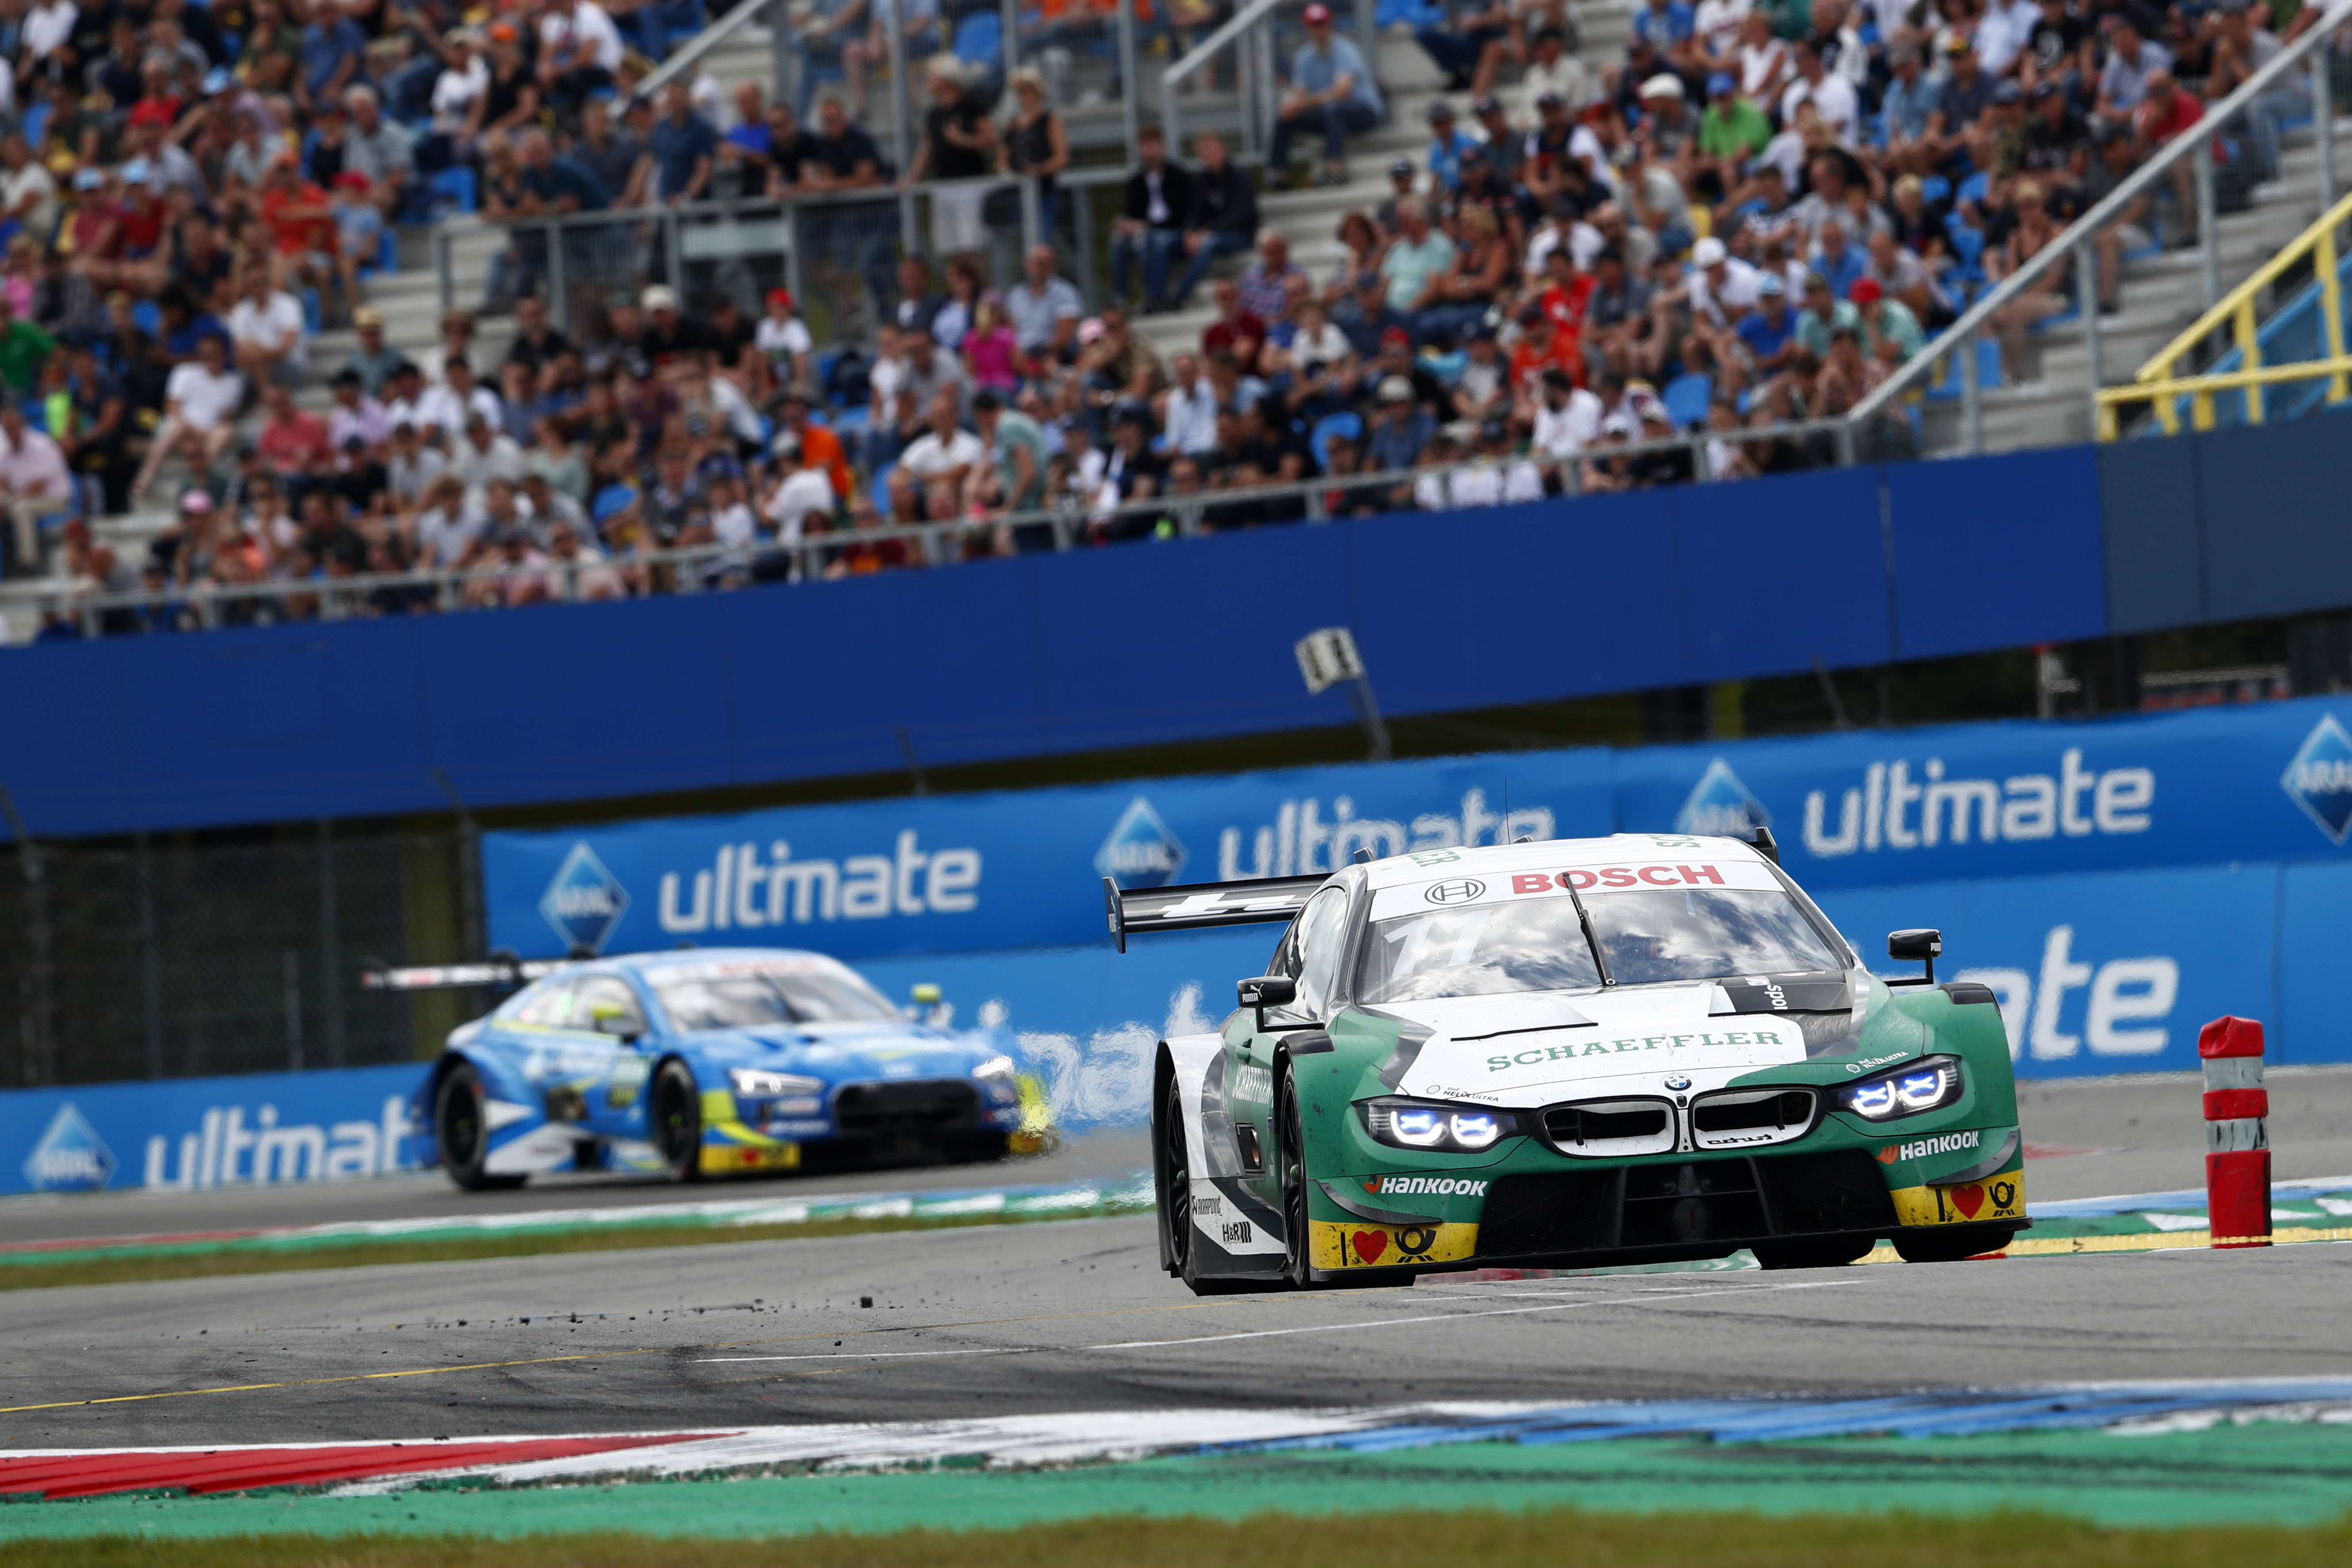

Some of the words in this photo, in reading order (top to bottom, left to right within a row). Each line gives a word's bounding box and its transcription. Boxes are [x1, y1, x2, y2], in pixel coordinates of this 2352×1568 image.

[1803, 747, 2156, 858] ultimate
[658, 828, 982, 932] ultimate
[1512, 865, 1725, 894] BOSCH
[1242, 993, 1259, 1003] PUMA
[1487, 1032, 1783, 1072] SCHAEFFLER
[143, 1094, 414, 1192] ultimat
[1222, 1223, 1240, 1244] H&R
